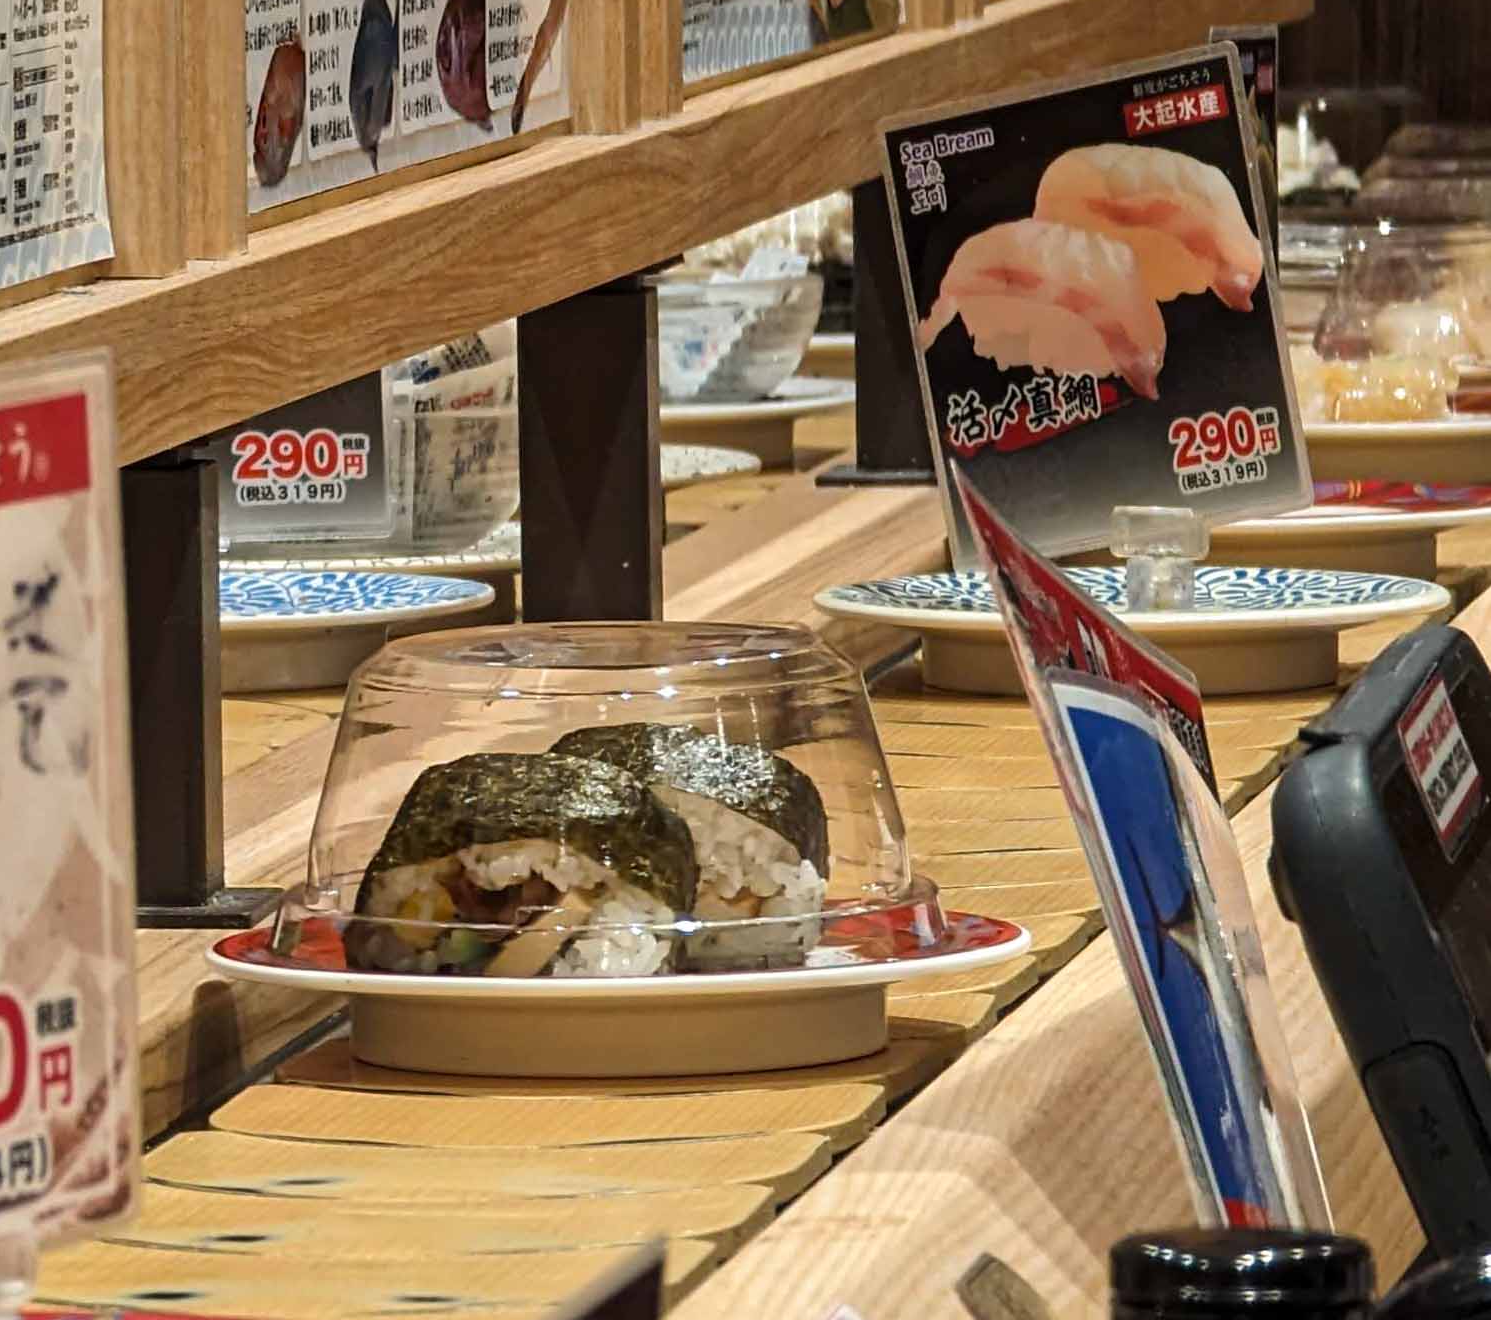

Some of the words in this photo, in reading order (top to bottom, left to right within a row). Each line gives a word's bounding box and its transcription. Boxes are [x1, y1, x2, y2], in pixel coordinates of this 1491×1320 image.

[1133, 92, 1221, 132] 大起水産
[901, 140, 933, 162] Sea
[938, 128, 994, 157] Bream
[910, 188, 947, 213] 도미
[240, 483, 344, 503] (税込319円)
